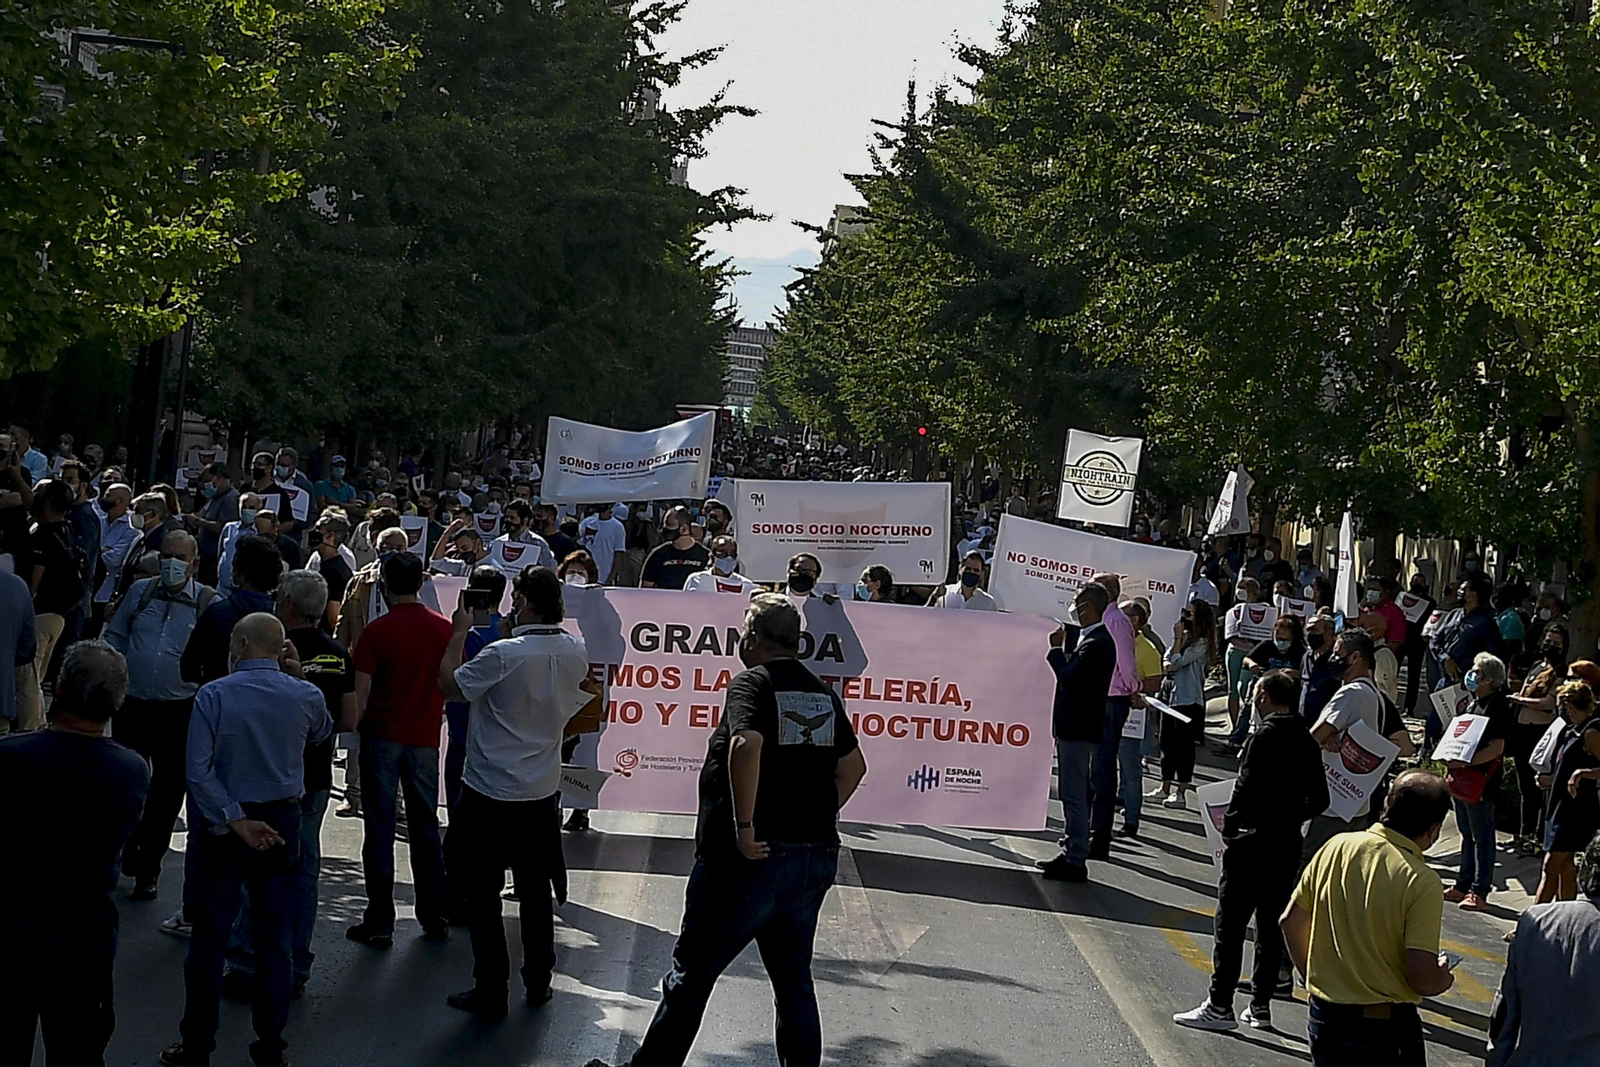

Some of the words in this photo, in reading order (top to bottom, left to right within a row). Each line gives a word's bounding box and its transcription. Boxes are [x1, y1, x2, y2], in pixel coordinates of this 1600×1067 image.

[558, 456, 600, 470] SOMOS
[604, 461, 634, 470] OCIO
[638, 447, 701, 467] NOCTURNO
[752, 524, 804, 534] SOMOS
[809, 524, 844, 535] OCIO
[850, 525, 932, 537] NOCTURNO
[1007, 552, 1026, 564] NO
[1030, 557, 1078, 574] SOMOS
[1025, 569, 1054, 581] SOMOS
[630, 622, 845, 663] GRANDA
[588, 663, 682, 690] EMOS
[820, 675, 972, 712] TELERÍA,
[655, 703, 679, 725] Y
[641, 755, 676, 763] Federación
[946, 768, 981, 777] ESPAÑA
[1329, 768, 1342, 781] ME
[1341, 778, 1364, 798] SUMO
